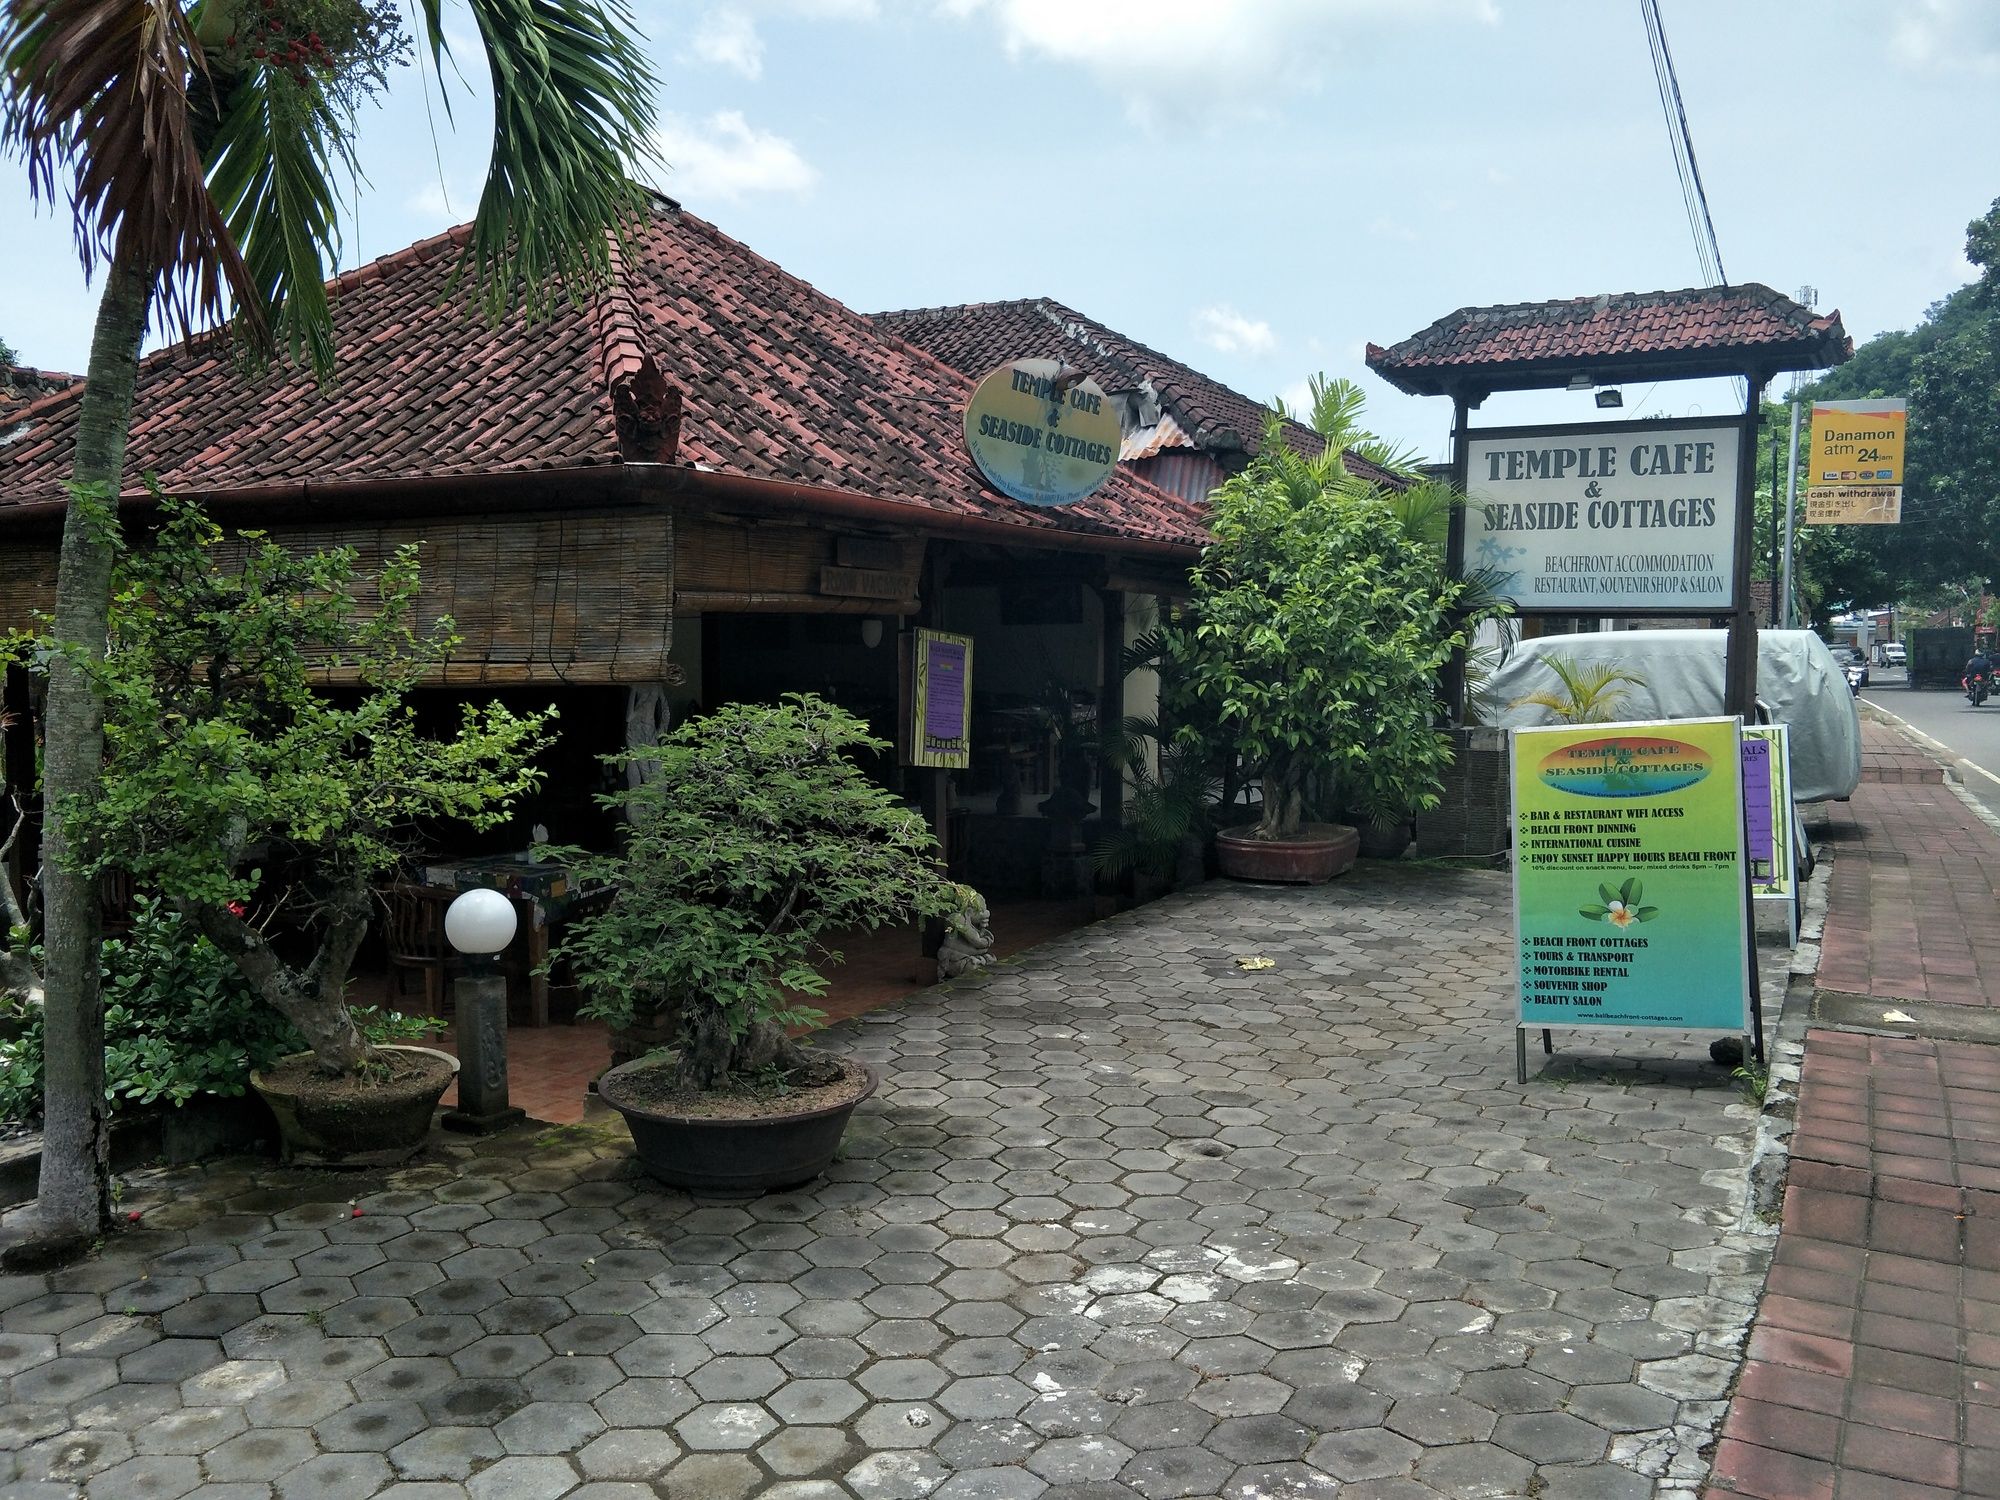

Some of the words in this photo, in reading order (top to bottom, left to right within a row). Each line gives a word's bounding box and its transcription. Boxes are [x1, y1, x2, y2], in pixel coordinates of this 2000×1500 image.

[1070, 388, 1102, 415] CAFE
[1046, 408, 1059, 428] &
[979, 414, 1043, 449] SEASIDE
[1046, 432, 1112, 465] COTTAGES
[1825, 430, 1895, 441] Danamon
[1824, 444, 1854, 455] atm
[1857, 448, 1879, 462] 24
[1485, 447, 1617, 481] TEMPLE
[1630, 442, 1715, 477] CAFE
[1584, 481, 1602, 498] &
[1811, 490, 1834, 498] cash
[1838, 489, 1896, 498] withdrawal
[1484, 501, 1579, 532] SEASIDE
[1588, 497, 1716, 530] COTTAGES
[1545, 555, 1613, 573] BEACHFRONT
[1615, 553, 1714, 572] ACCOMMODATION
[1534, 576, 1599, 595] RESTAURANT,
[1600, 576, 1650, 594] SOUVENIR
[1651, 576, 1678, 593] SHOP
[1680, 578, 1689, 593] &
[1689, 575, 1724, 593] SALON
[1567, 748, 1632, 759] TEMPLE
[1637, 745, 1680, 756] CAFE
[1545, 766, 1614, 776] SEASIDE
[1618, 763, 1704, 775] COTTAGES
[1530, 811, 1550, 820] BAR
[1553, 811, 1561, 820] &
[1564, 809, 1623, 820] RESTAURANT
[1626, 808, 1648, 818] WIFI
[1652, 808, 1684, 818] ACCESS
[1531, 825, 1561, 835] BEACH
[1564, 824, 1594, 834] FRONT
[1597, 823, 1636, 833] DINNING
[1531, 839, 1603, 849] INTERNATIONAL
[1607, 838, 1641, 848] CUISINE
[1532, 854, 1559, 864] ENJOY
[1561, 853, 1594, 863] SUNSET
[1597, 853, 1630, 862] HAPPY
[1633, 852, 1665, 862] HOURS
[1669, 852, 1700, 861] BEACH
[1704, 851, 1736, 861] FRONT
[1533, 937, 1563, 947] BEACH
[1566, 937, 1597, 947] FRONT
[1600, 938, 1649, 948] COTTAGES
[1533, 951, 1563, 961] TOURS
[1567, 952, 1575, 961] &
[1578, 952, 1634, 962] TRANSPORT
[1533, 966, 1590, 976] MOTORBIKE
[1593, 968, 1629, 977] RENTAL
[1534, 980, 1578, 990] SOUVENIR
[1582, 982, 1608, 991] SHOP
[1534, 995, 1570, 1005] BEAUTY
[1573, 996, 1602, 1006] SALON
